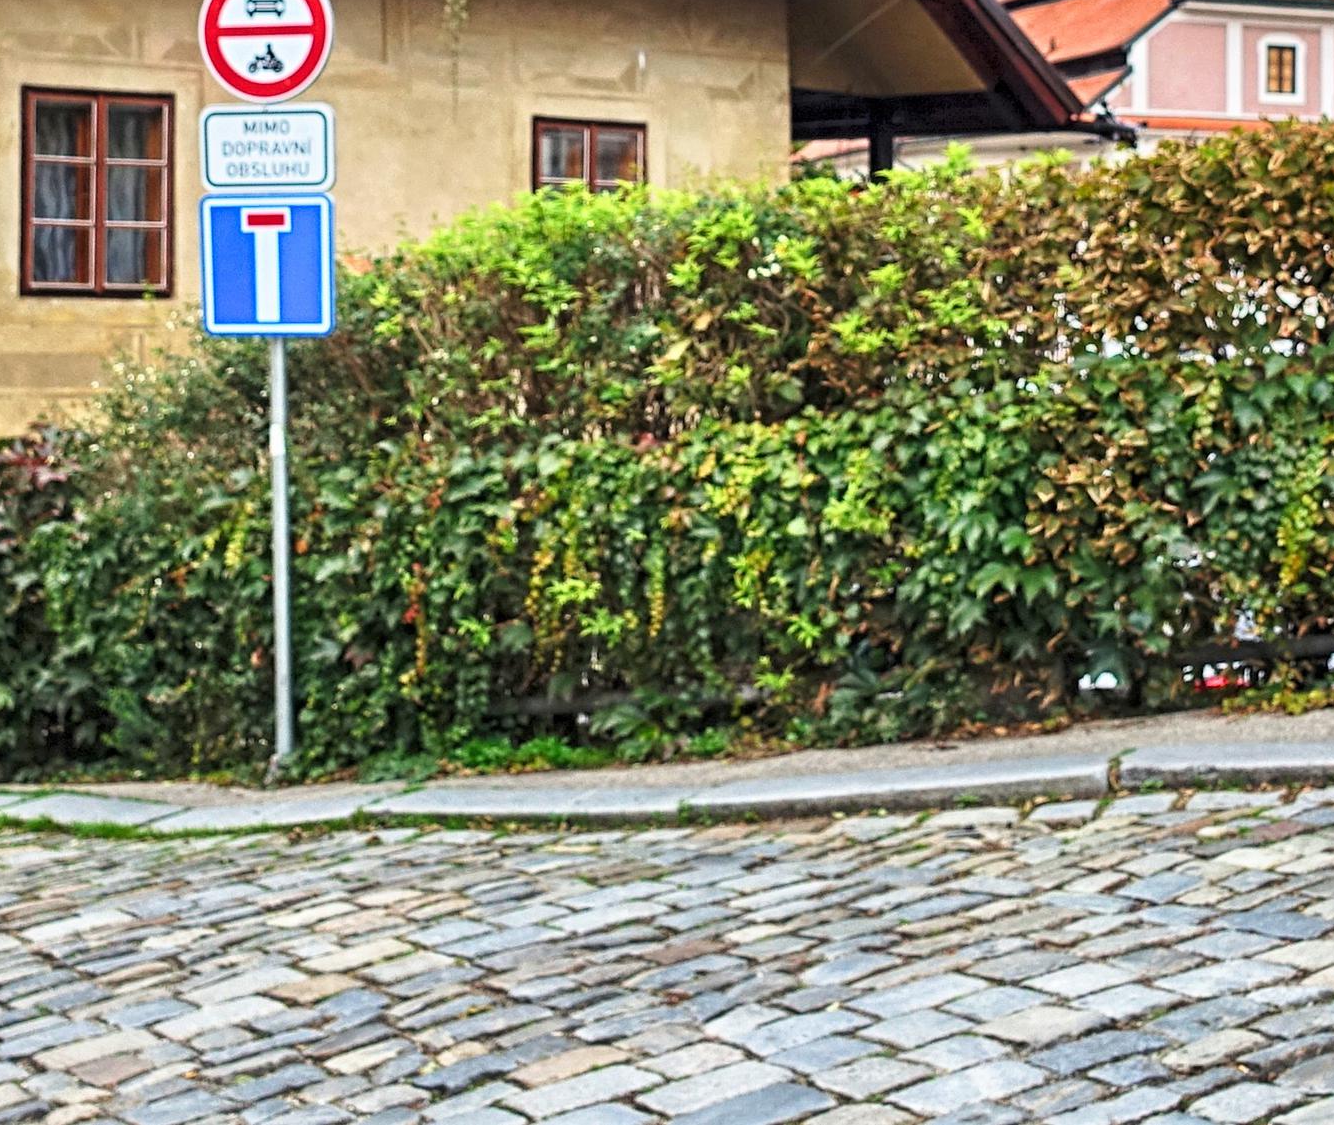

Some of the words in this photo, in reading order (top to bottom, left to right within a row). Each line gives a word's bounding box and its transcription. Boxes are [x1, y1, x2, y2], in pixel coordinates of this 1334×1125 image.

[243, 119, 290, 134] MIMO
[222, 137, 312, 156] DOPRAVNÍ
[226, 161, 310, 178] OBSLUHU
